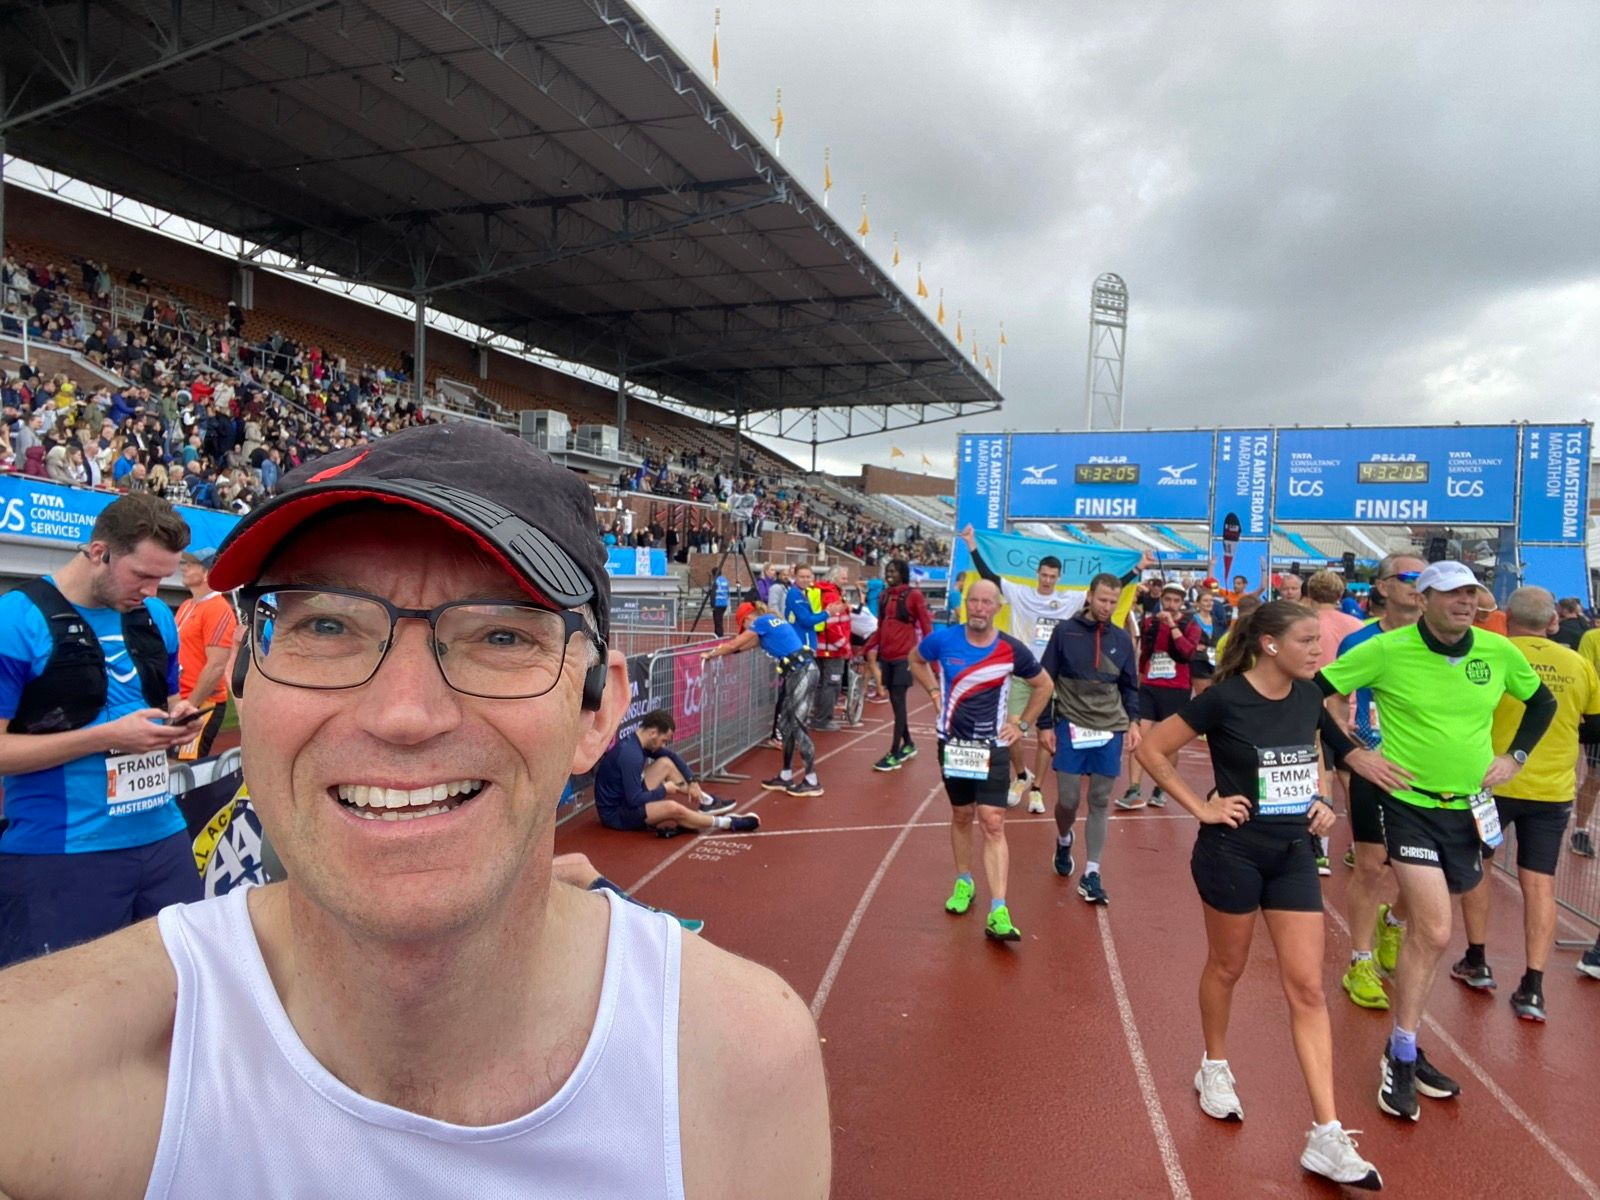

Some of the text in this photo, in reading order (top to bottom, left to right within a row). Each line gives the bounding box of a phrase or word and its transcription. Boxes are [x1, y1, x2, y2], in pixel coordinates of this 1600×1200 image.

[976, 440, 989, 495] MARATHON
[1088, 456, 1128, 464] POLAR
[1237, 435, 1252, 496] MARATHON
[1371, 453, 1417, 462] POLAR
[1546, 432, 1563, 497] MARATHON
[987, 439, 1003, 529] TCS AMSTERDAM
[1079, 467, 1137, 481] 4:32:05
[1251, 435, 1268, 533] TCS AMSTERDAM
[1289, 476, 1324, 497] tcs
[1447, 475, 1485, 497] tcs
[1562, 431, 1582, 538] TCS AMSTERDAM
[30, 492, 65, 508] TATA
[1075, 498, 1137, 517] FINISH
[1355, 499, 1428, 519] FINISH
[31, 521, 81, 539] SERVICES
[1006, 549, 1102, 576] Сегій
[949, 748, 984, 760] MARTIN
[1280, 752, 1298, 764] tcs
[1271, 768, 1311, 783] EMMA
[1275, 784, 1312, 798] 14316
[108, 795, 164, 816] AMSTERDAM
